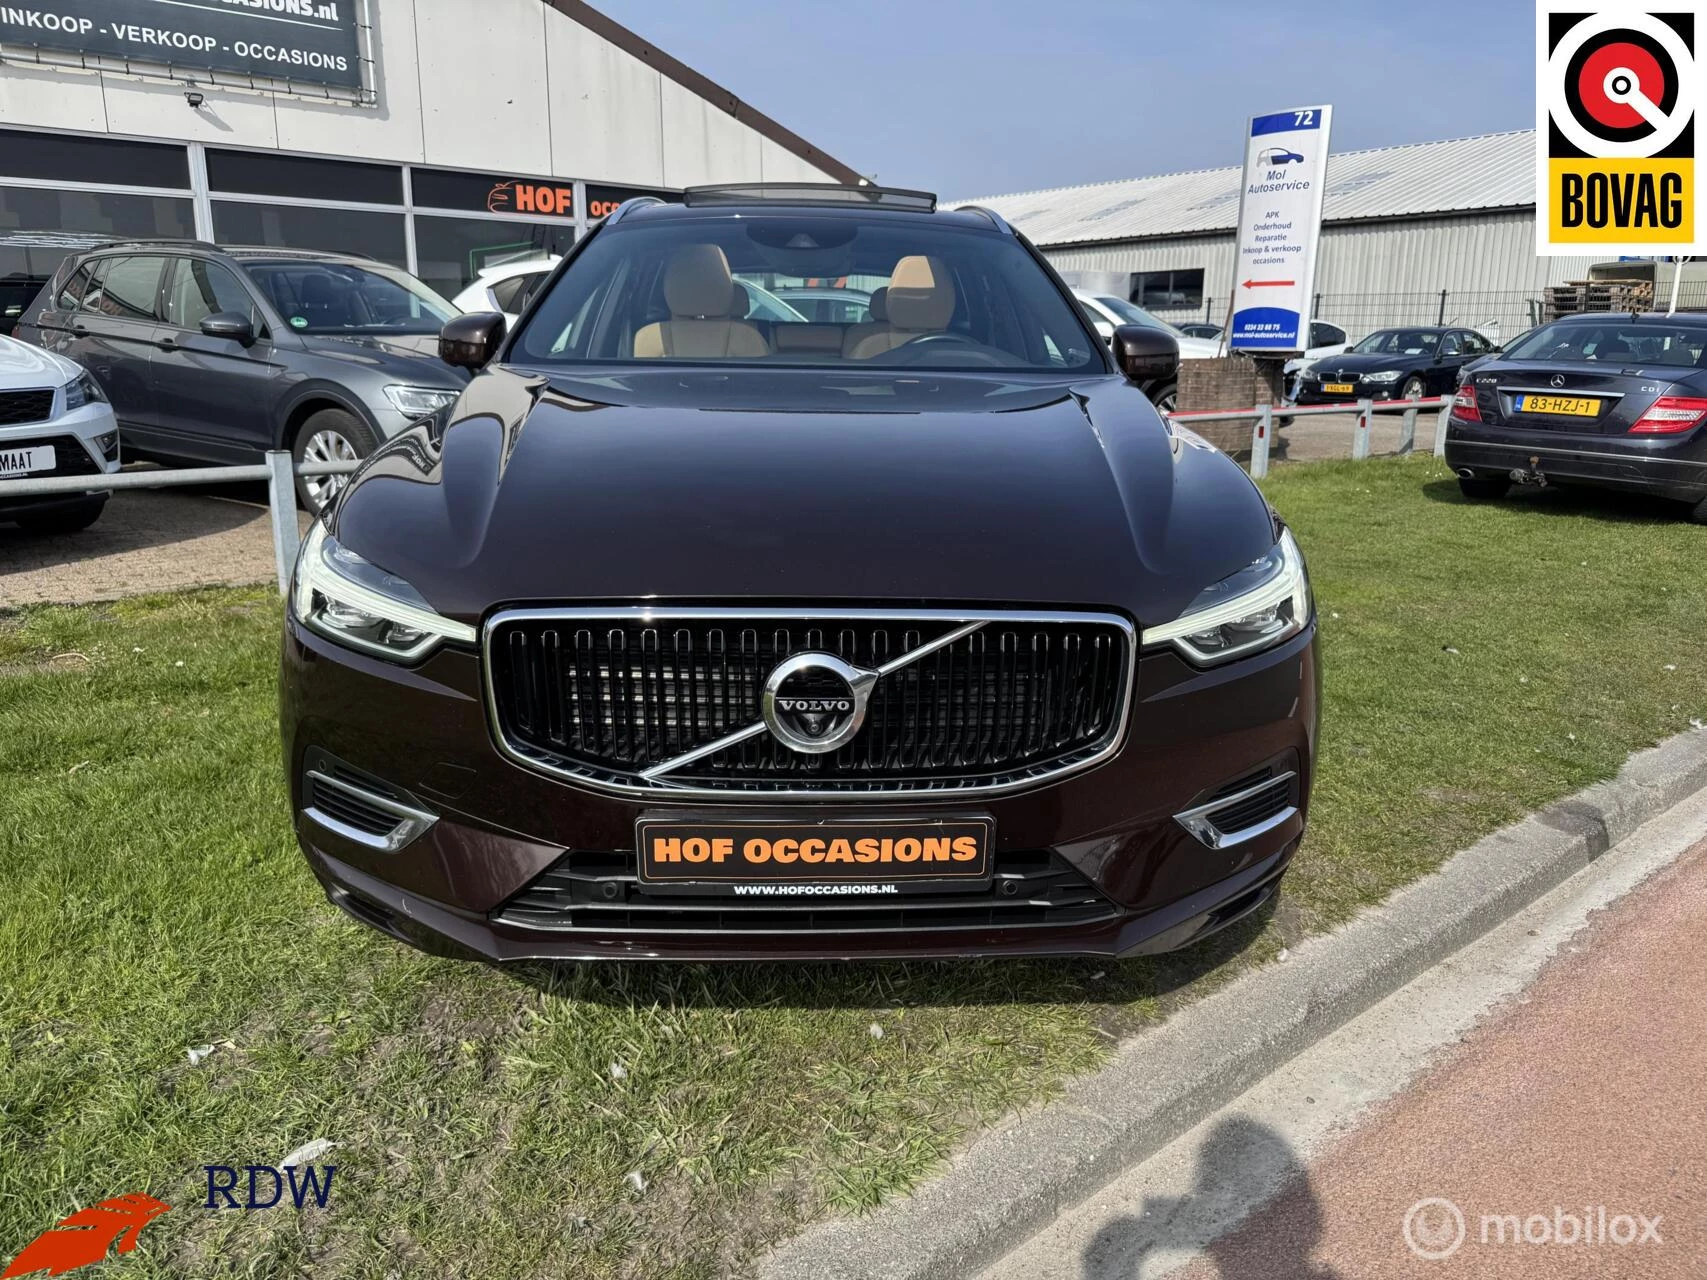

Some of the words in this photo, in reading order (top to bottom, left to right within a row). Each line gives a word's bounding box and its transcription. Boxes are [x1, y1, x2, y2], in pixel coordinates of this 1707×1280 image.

[1, 7, 93, 34] INKOOP
[111, 23, 217, 51] VERKOOP
[234, 41, 348, 71] OCCASIONS
[1294, 110, 1314, 127] 72
[1266, 169, 1287, 181] Mol
[1247, 180, 1310, 194] Autoservice
[515, 184, 571, 214] HOF
[1265, 211, 1280, 219] APK
[1253, 221, 1292, 231] Onderhoud
[1254, 234, 1288, 243] Reparatie
[1271, 244, 1302, 254] verkoop
[1252, 256, 1285, 265] occasions
[1529, 396, 1591, 413] 83-HZJ-1
[779, 700, 850, 711] VOLVO
[653, 838, 733, 863] HOF
[743, 836, 977, 863] OCCASIONS
[734, 885, 898, 896] WWW.HOFOCCASIONS.NL
